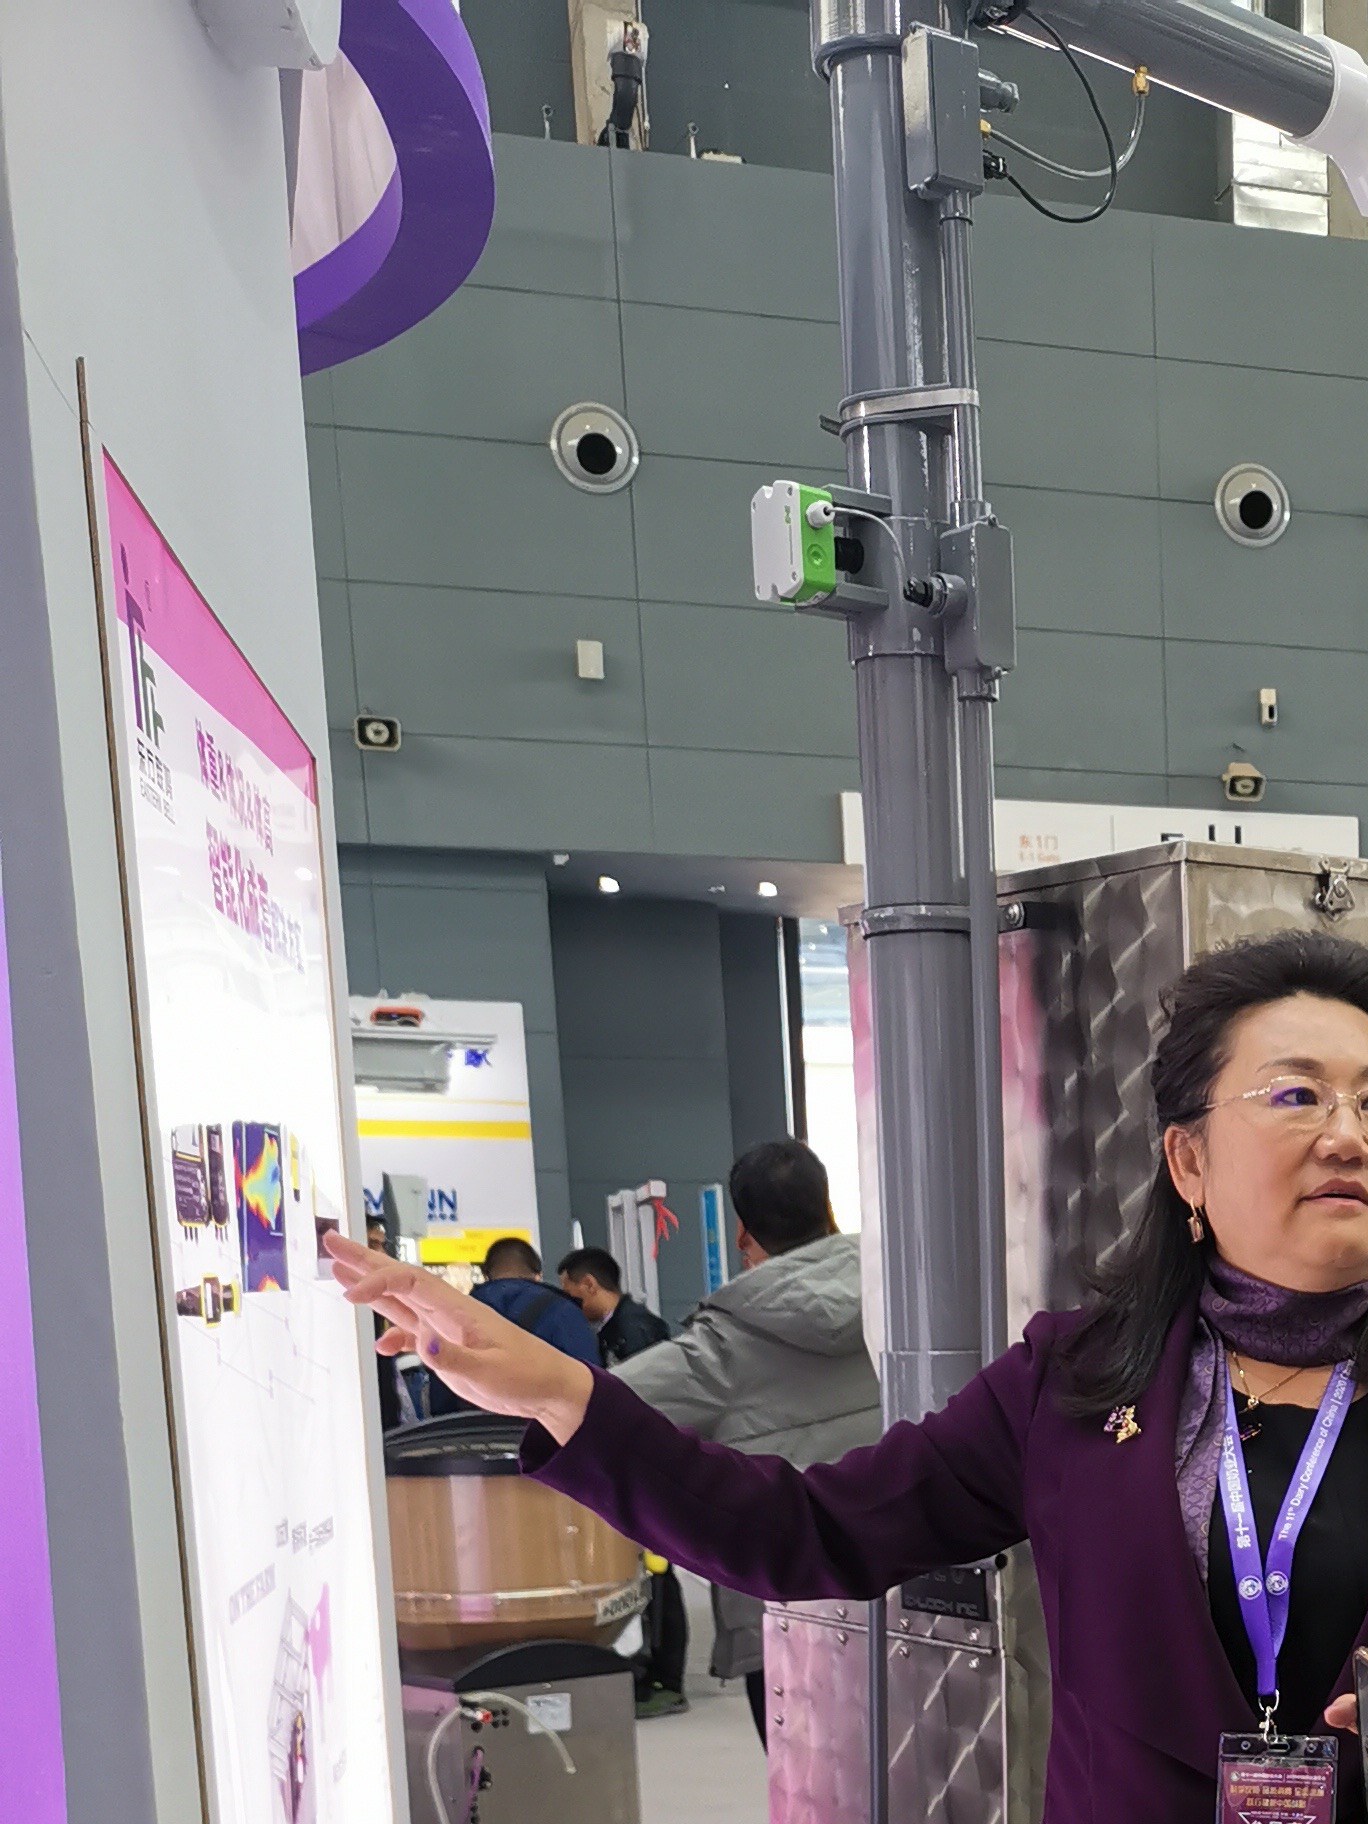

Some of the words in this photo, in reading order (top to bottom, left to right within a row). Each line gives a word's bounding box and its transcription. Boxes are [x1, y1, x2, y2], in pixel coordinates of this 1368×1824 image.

[1278, 1521, 1292, 1540] The
[1290, 1482, 1309, 1507] Dairy
[1300, 1436, 1326, 1483] Conference
